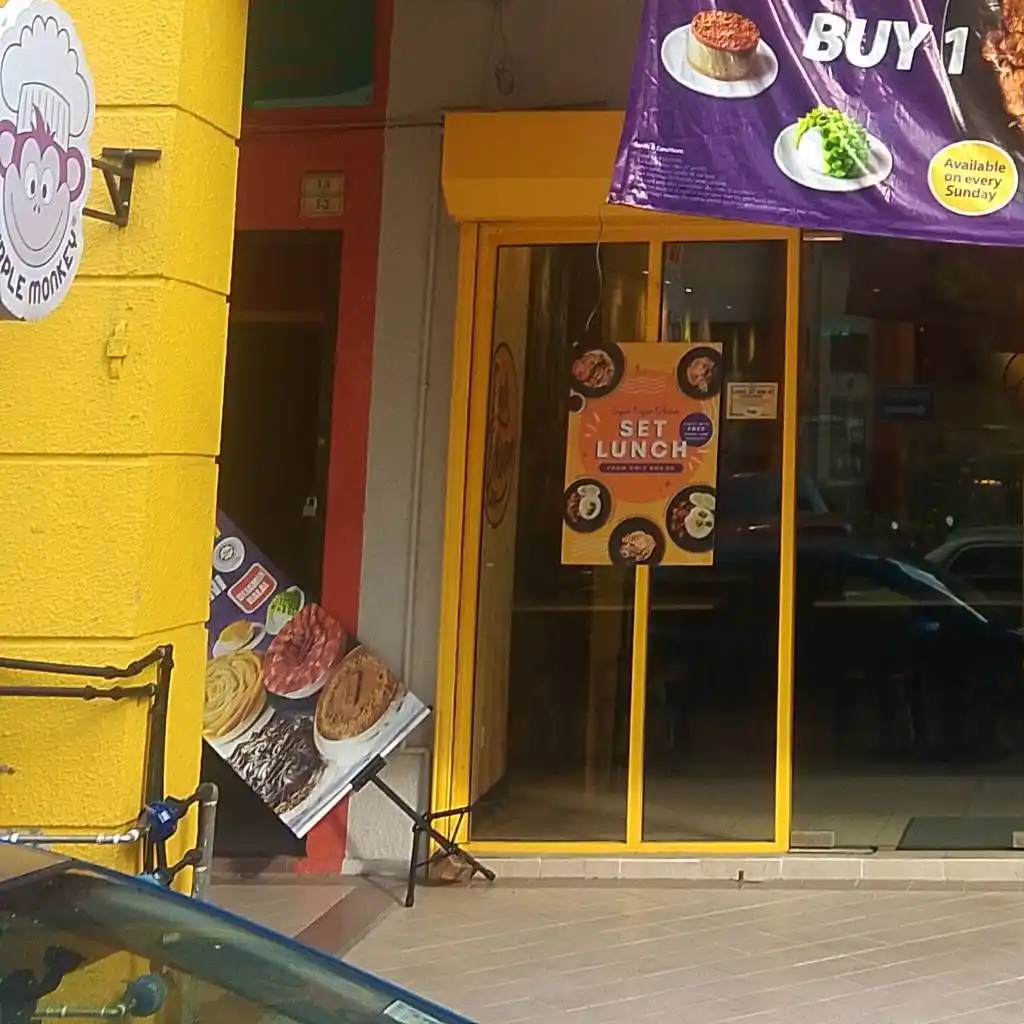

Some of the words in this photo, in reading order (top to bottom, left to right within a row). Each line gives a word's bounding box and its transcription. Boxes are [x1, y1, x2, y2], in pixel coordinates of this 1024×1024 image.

[803, 12, 934, 71] BUY
[945, 27, 969, 75] 1
[944, 158, 1006, 174] Available
[944, 173, 961, 182] on
[965, 176, 1003, 189] every
[945, 185, 997, 203] Sunday
[29, 229, 77, 304] MONKEY
[620, 419, 668, 438] SET
[596, 440, 687, 459] LUNCH
